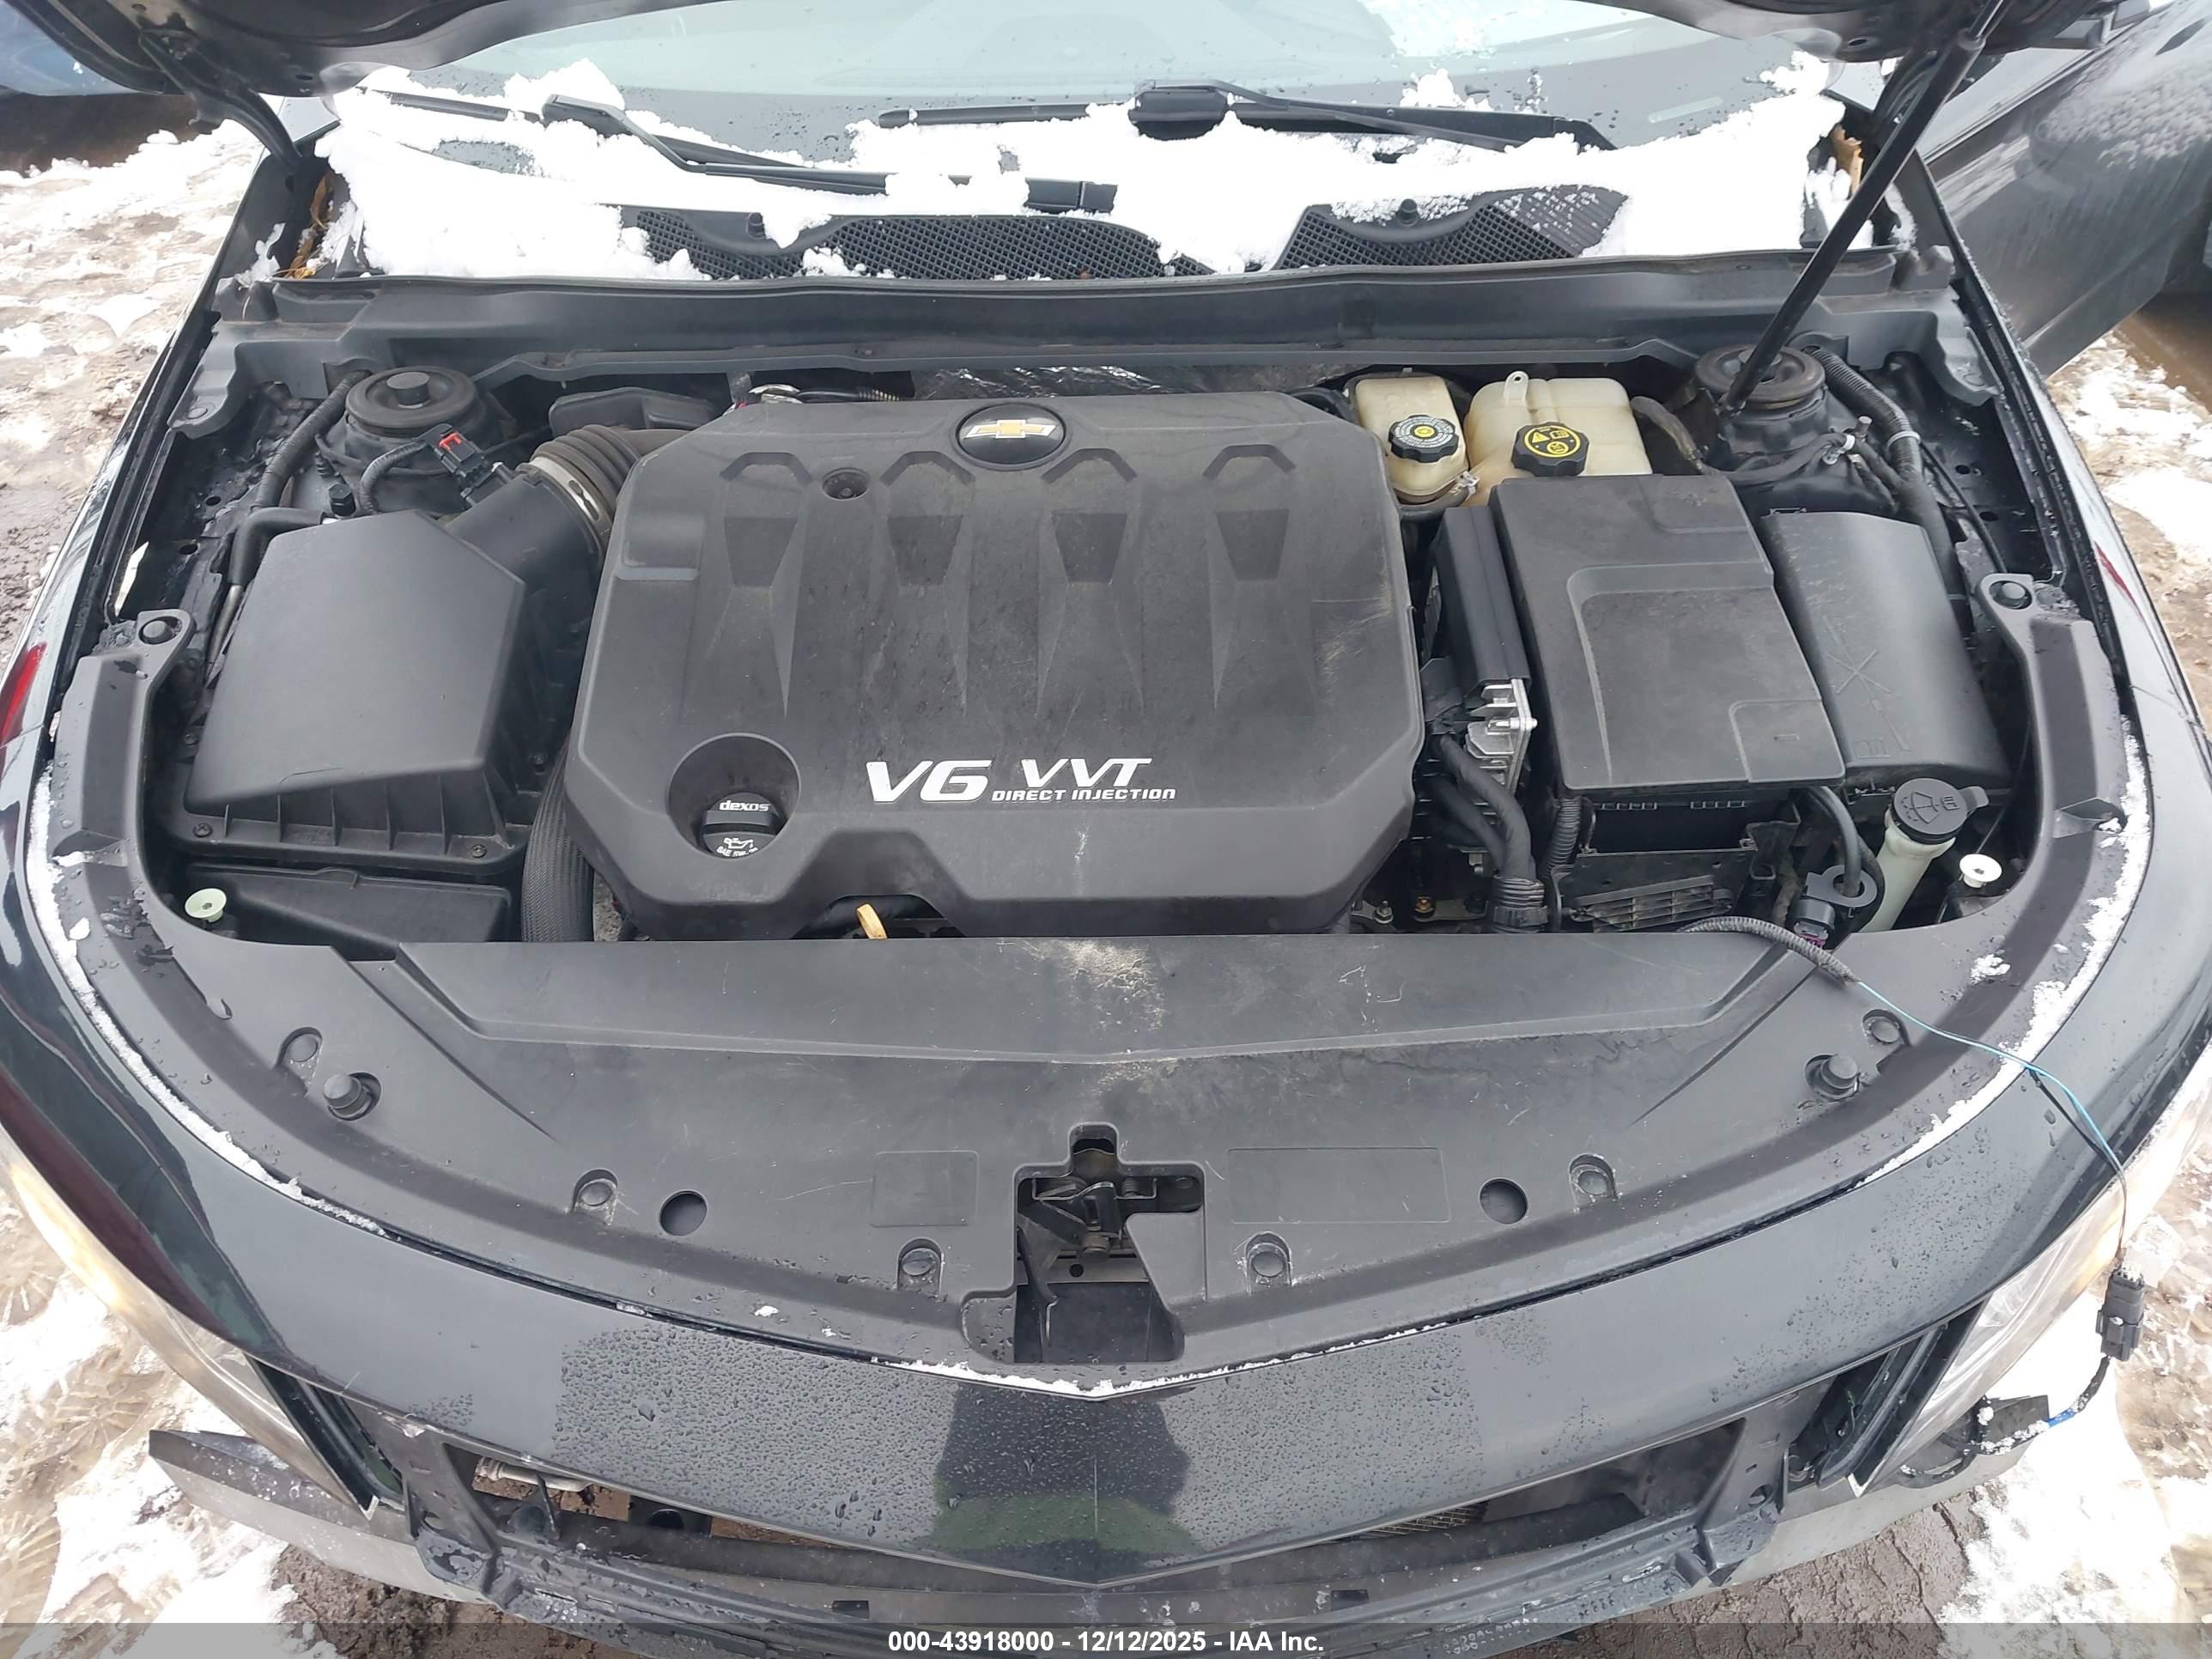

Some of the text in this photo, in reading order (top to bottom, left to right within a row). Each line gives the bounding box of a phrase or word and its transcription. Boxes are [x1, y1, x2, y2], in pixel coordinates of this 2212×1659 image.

[866, 757, 1152, 803] V6 VVT
[991, 788, 1177, 802] DIRECT INJECTION
[719, 799, 771, 812] dexos
